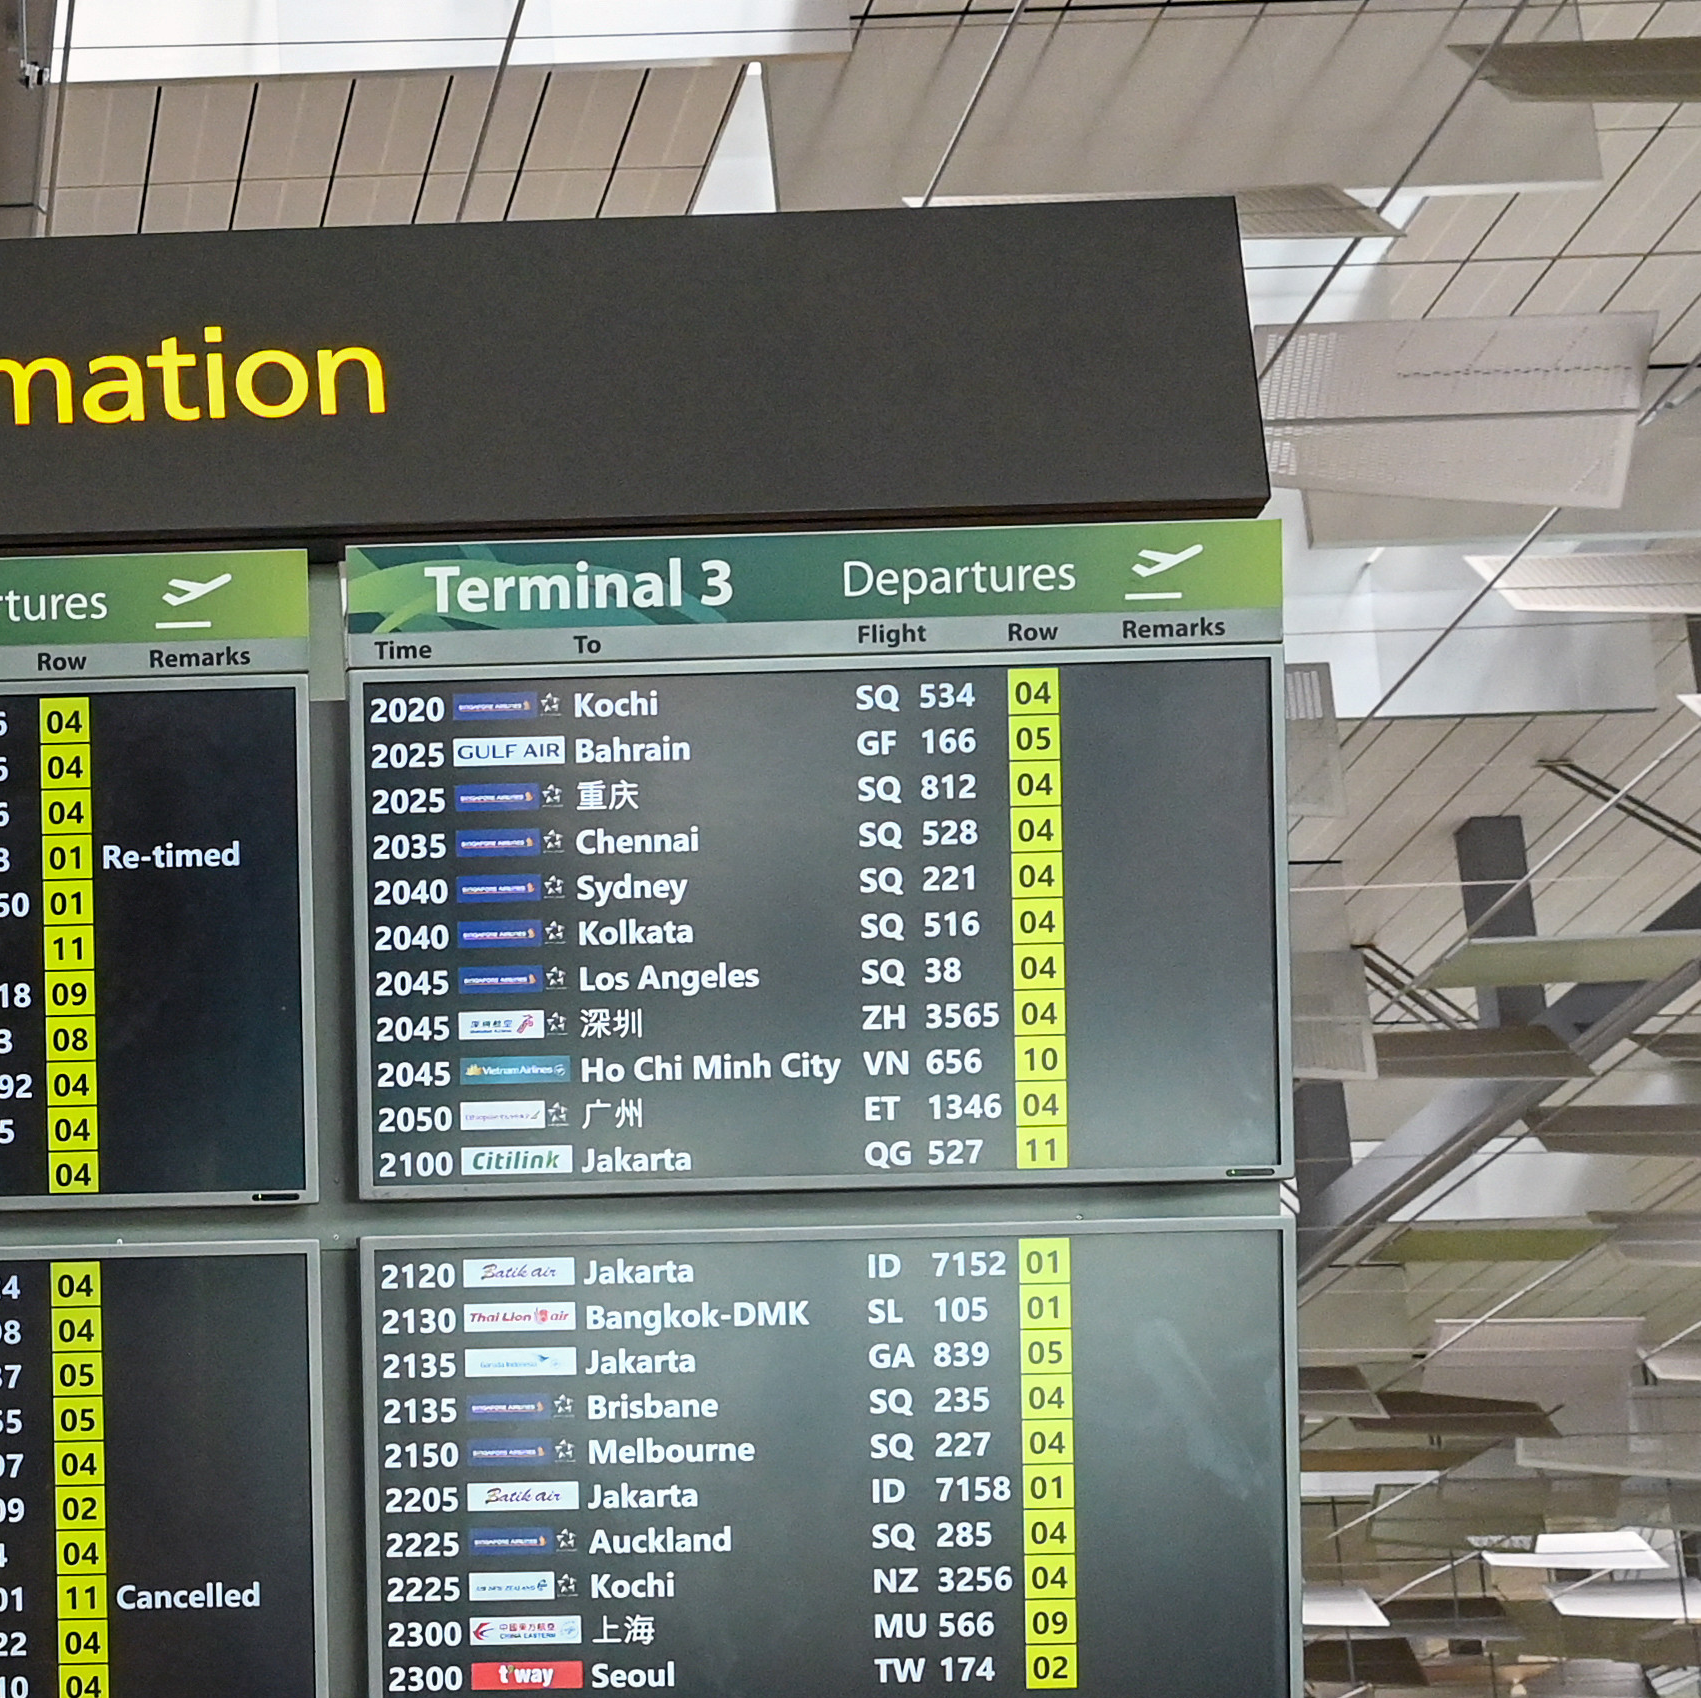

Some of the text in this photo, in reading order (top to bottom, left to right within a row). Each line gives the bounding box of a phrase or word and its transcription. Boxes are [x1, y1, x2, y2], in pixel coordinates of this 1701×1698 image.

[423, 557, 733, 614] Terminal 3
[843, 560, 1076, 605] Departures
[857, 622, 927, 648] Flight
[1008, 622, 1059, 642] Row
[1121, 615, 1227, 640] Remarks
[373, 641, 432, 660] Time
[573, 635, 601, 654] To
[371, 726, 1051, 769] 2025 GULF AIR Bahrain GF 166 05
[49, 845, 82, 871] 01
[102, 840, 241, 870] Re-timed
[53, 1073, 90, 1098] 04
[379, 1137, 1056, 1178] 2100 Citilink Jakarta QG 527 11
[66, 1585, 98, 1610] 11
[116, 1580, 261, 1610] Cancelled
[388, 1655, 1068, 1692] 2300 t'way Seoul TW 174 02
